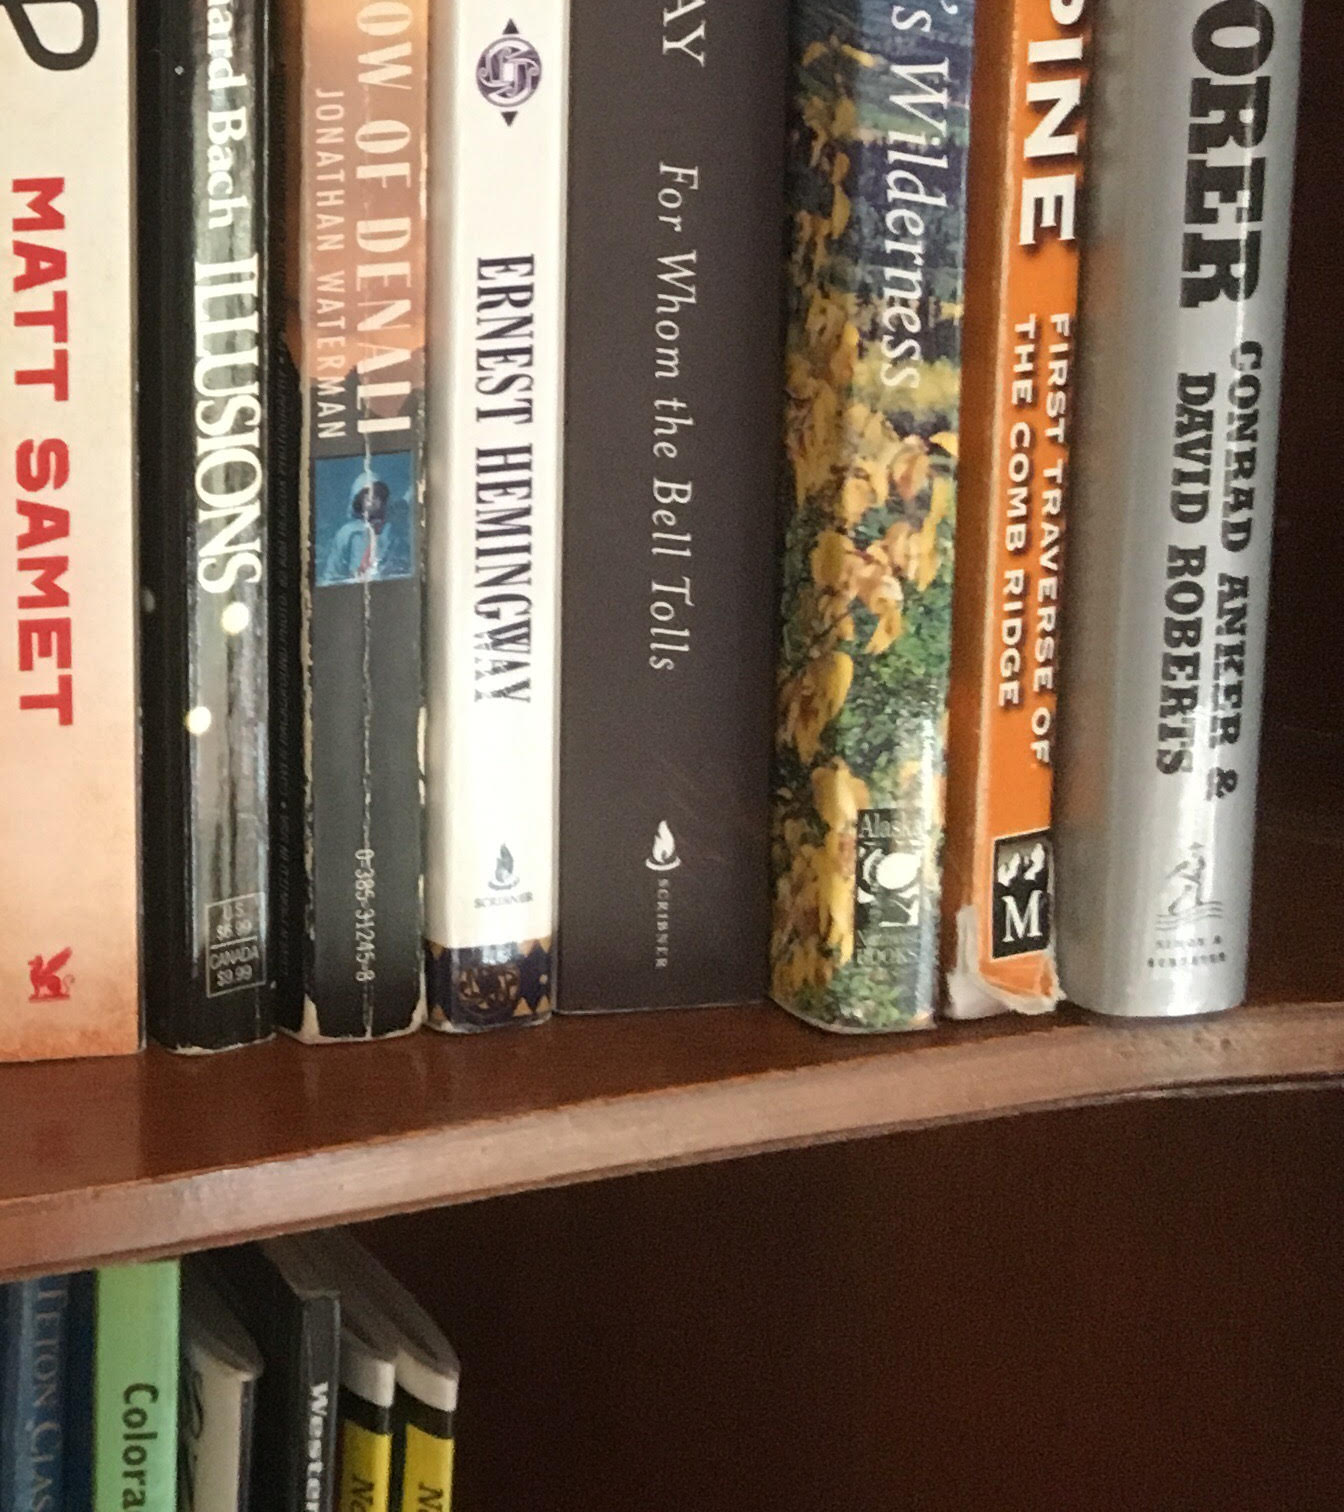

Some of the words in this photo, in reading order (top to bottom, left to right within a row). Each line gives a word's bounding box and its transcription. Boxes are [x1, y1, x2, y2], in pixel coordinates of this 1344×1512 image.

[207, 109, 250, 229] Bach
[315, 89, 345, 251] JONATHAN
[354, 119, 411, 194] OF
[11, 176, 69, 402] MATT
[316, 269, 346, 440] WATERMAN
[355, 216, 412, 434] DENALI
[475, 254, 535, 424] ERNEST
[1013, 314, 1037, 405] THE
[1005, 425, 1032, 553] COMB
[1171, 372, 1215, 524] DAVID
[14, 437, 74, 726] SAMET
[473, 442, 535, 704] HEMINGWAY
[999, 568, 1024, 707] RIDGE
[1155, 545, 1207, 776] ROBERTS
